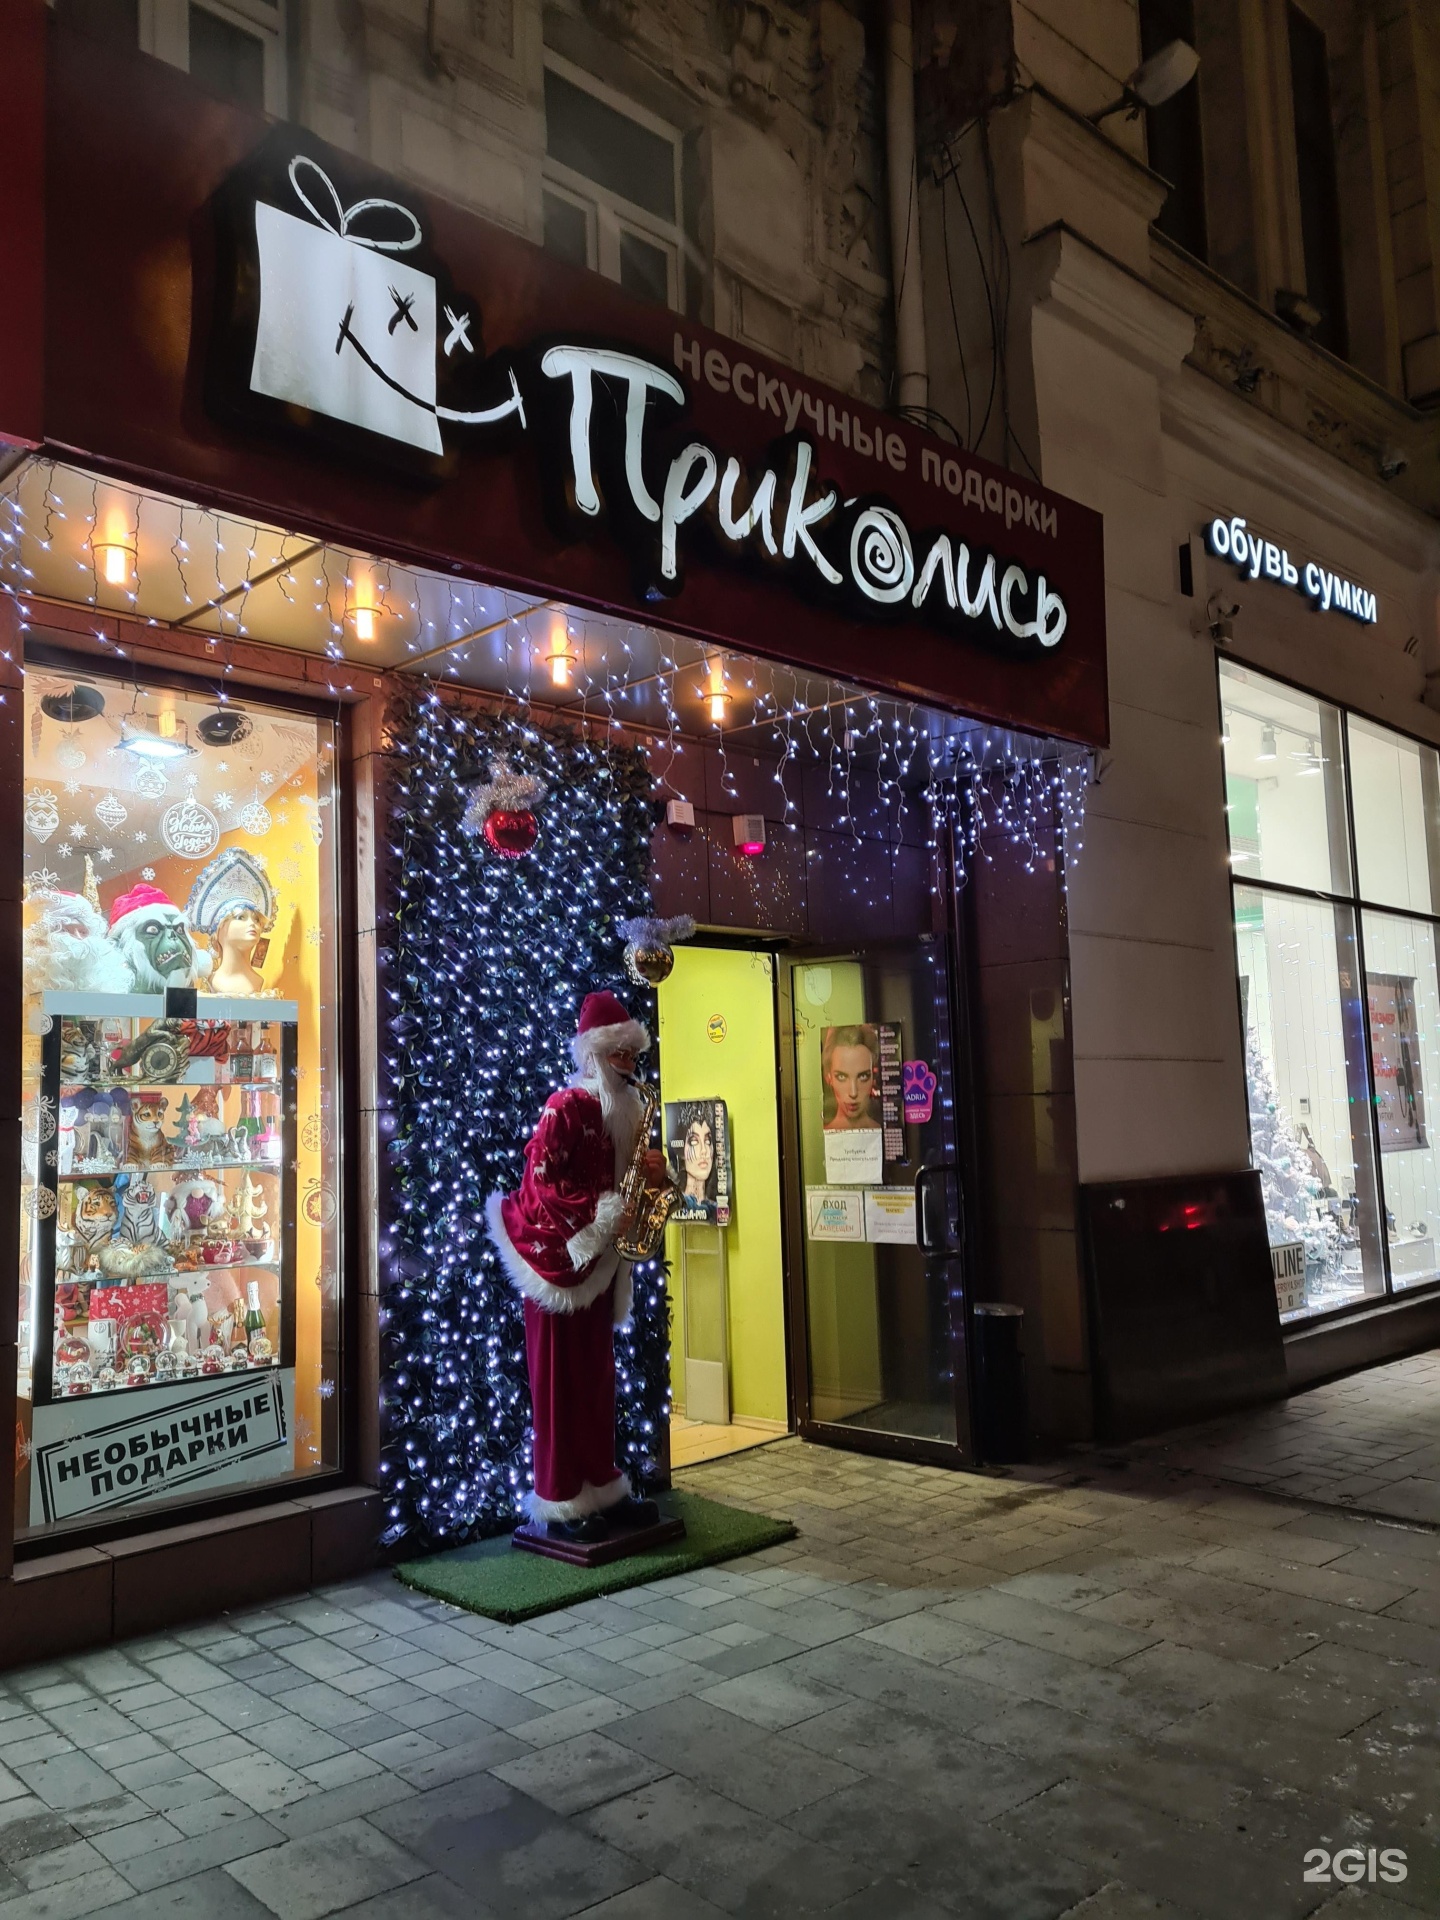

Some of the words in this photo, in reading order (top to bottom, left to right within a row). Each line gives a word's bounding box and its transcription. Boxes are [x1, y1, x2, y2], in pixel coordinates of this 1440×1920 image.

[673, 332, 907, 471] нескучные
[920, 448, 1059, 539] подарки
[1210, 516, 1300, 585] обувь
[1305, 561, 1378, 625] сумки
[905, 1093, 927, 1101] ADRIA
[822, 1199, 847, 1211] ВХОД
[57, 1392, 271, 1483] НЕОБЫЧНЫЕ
[90, 1423, 249, 1497] ПОДАРКИ
